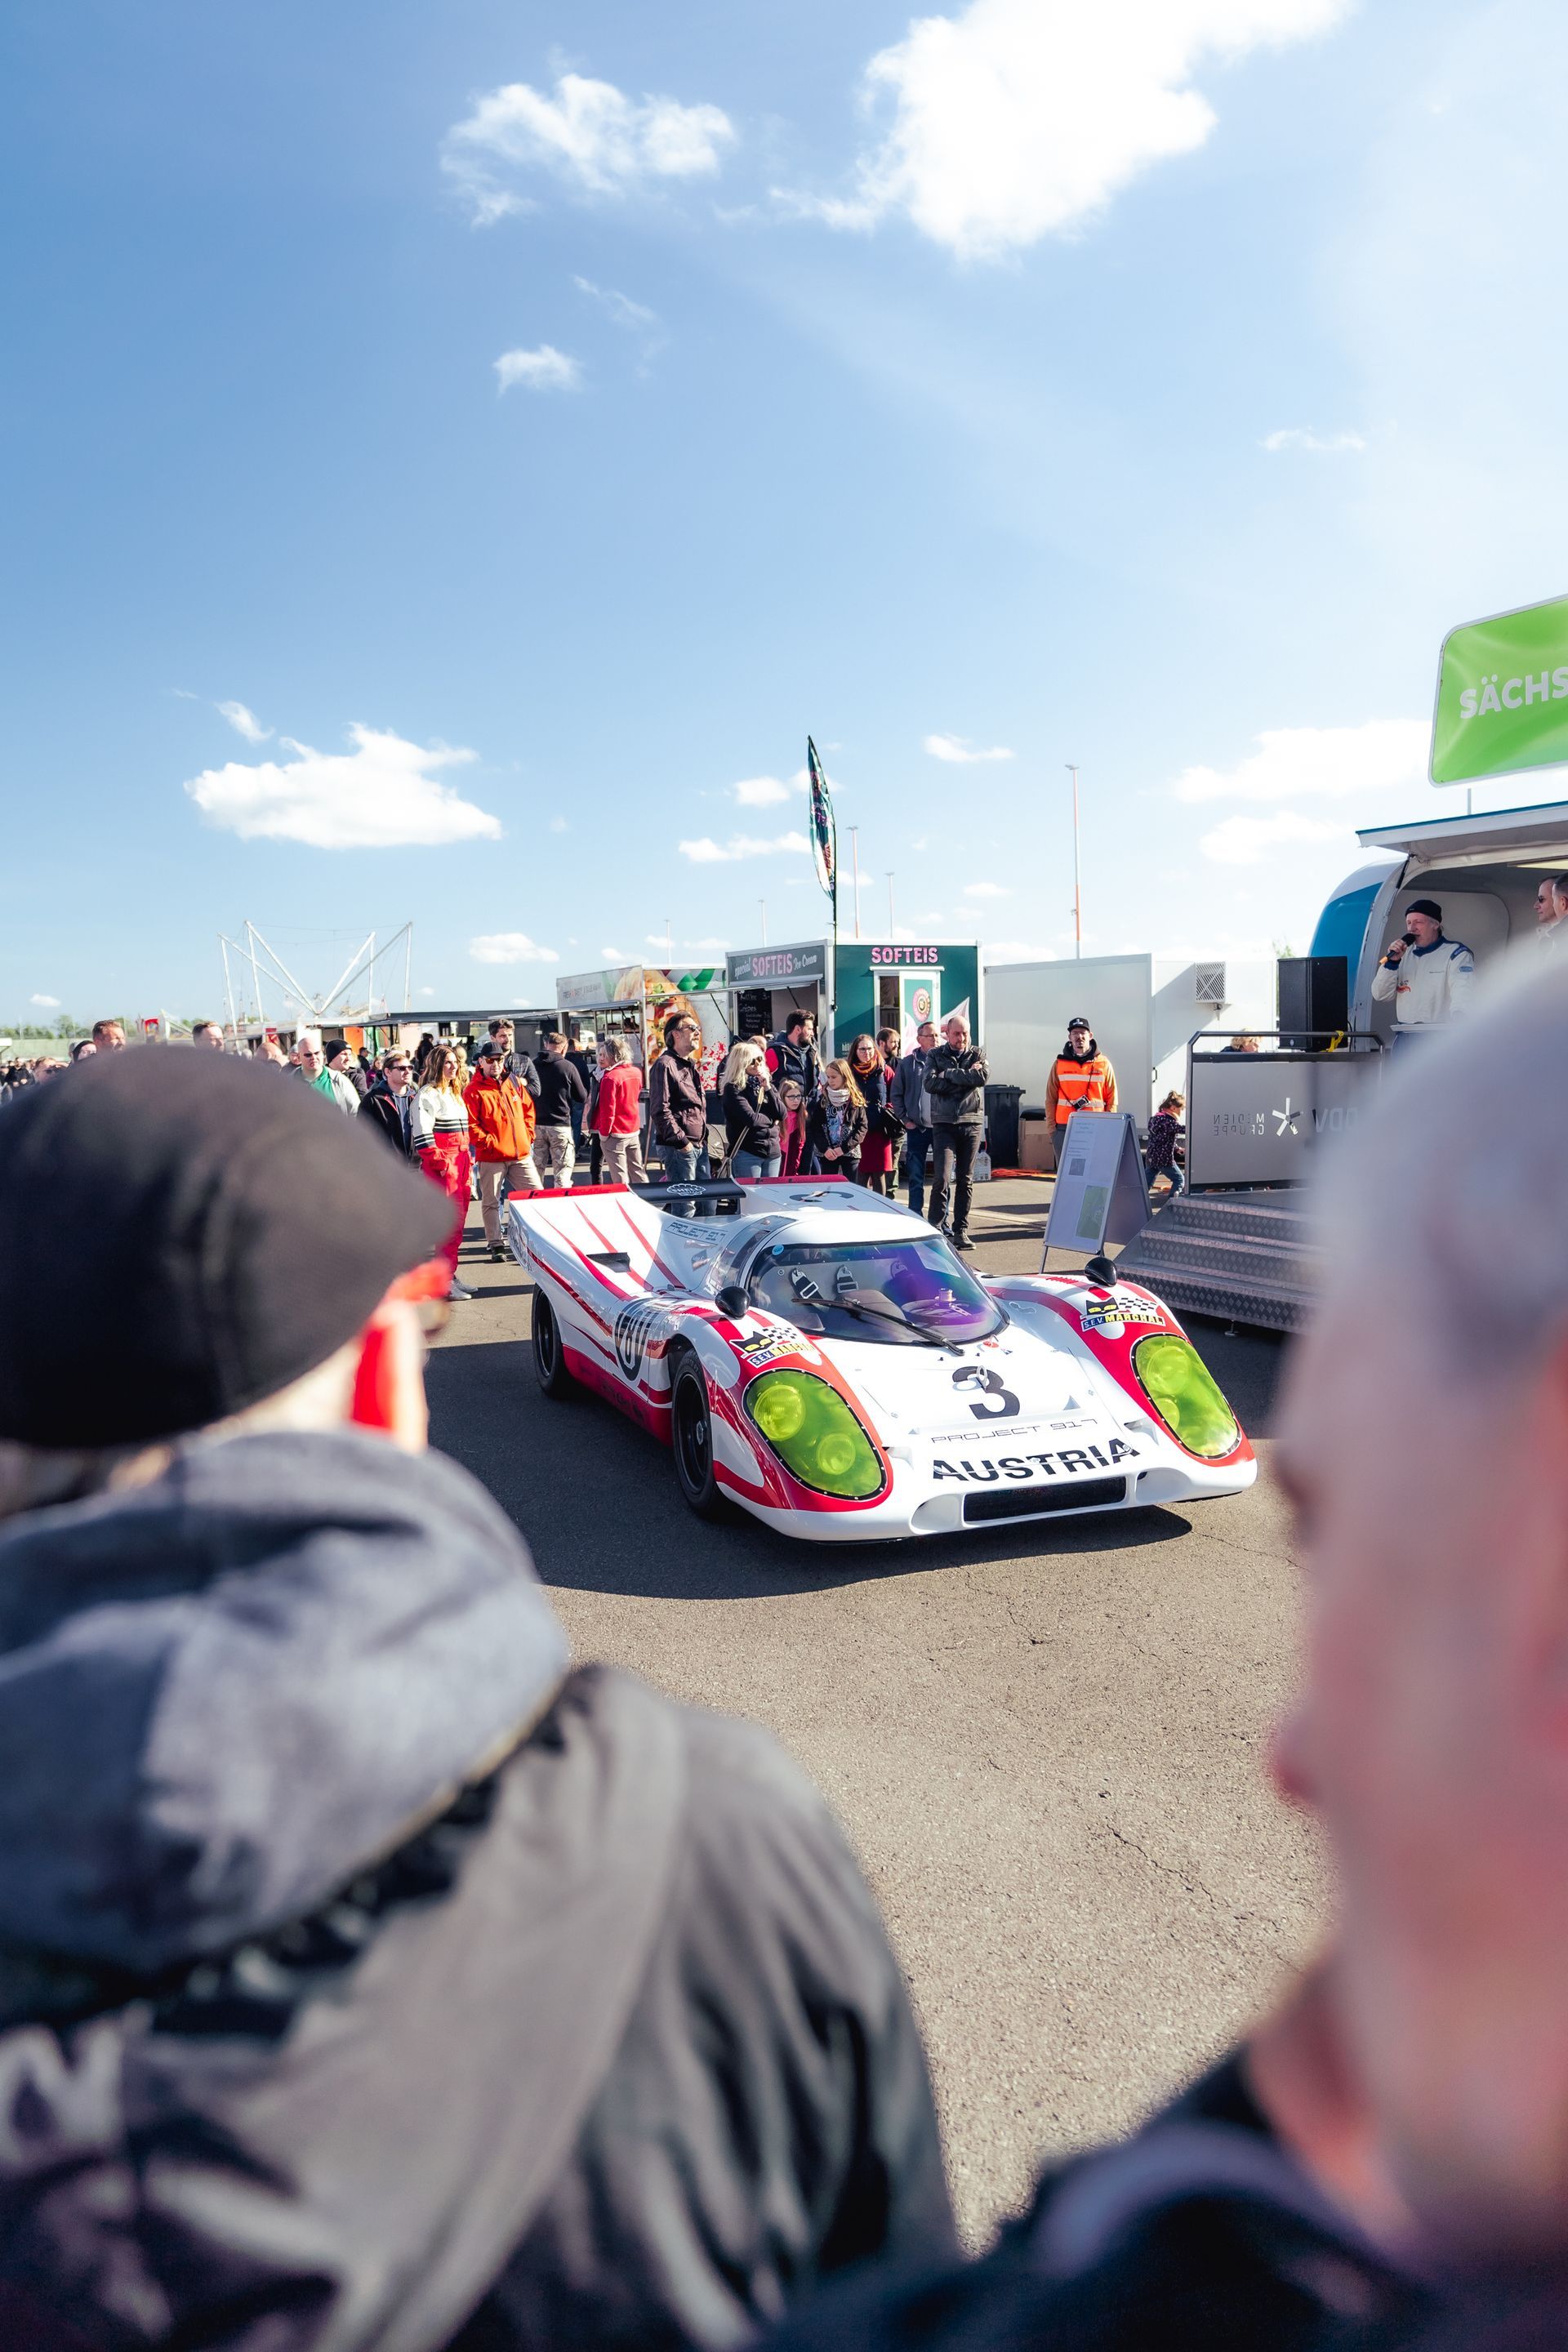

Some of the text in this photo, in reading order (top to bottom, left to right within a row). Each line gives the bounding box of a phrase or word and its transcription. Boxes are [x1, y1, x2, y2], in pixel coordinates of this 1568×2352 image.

[1459, 665, 1568, 719] SÄCHS
[752, 952, 794, 978] SOFTEIS
[871, 947, 938, 964] SOFTEIS
[667, 1222, 726, 1242] PROJECT 917
[1084, 1314, 1164, 1329] S.E.V. MARCHAL
[751, 1351, 776, 1365] S.E.V.
[952, 1365, 1020, 1420] 3
[931, 1419, 1098, 1444] PROJECT 917
[933, 1437, 1141, 1481] AUSTRIA
